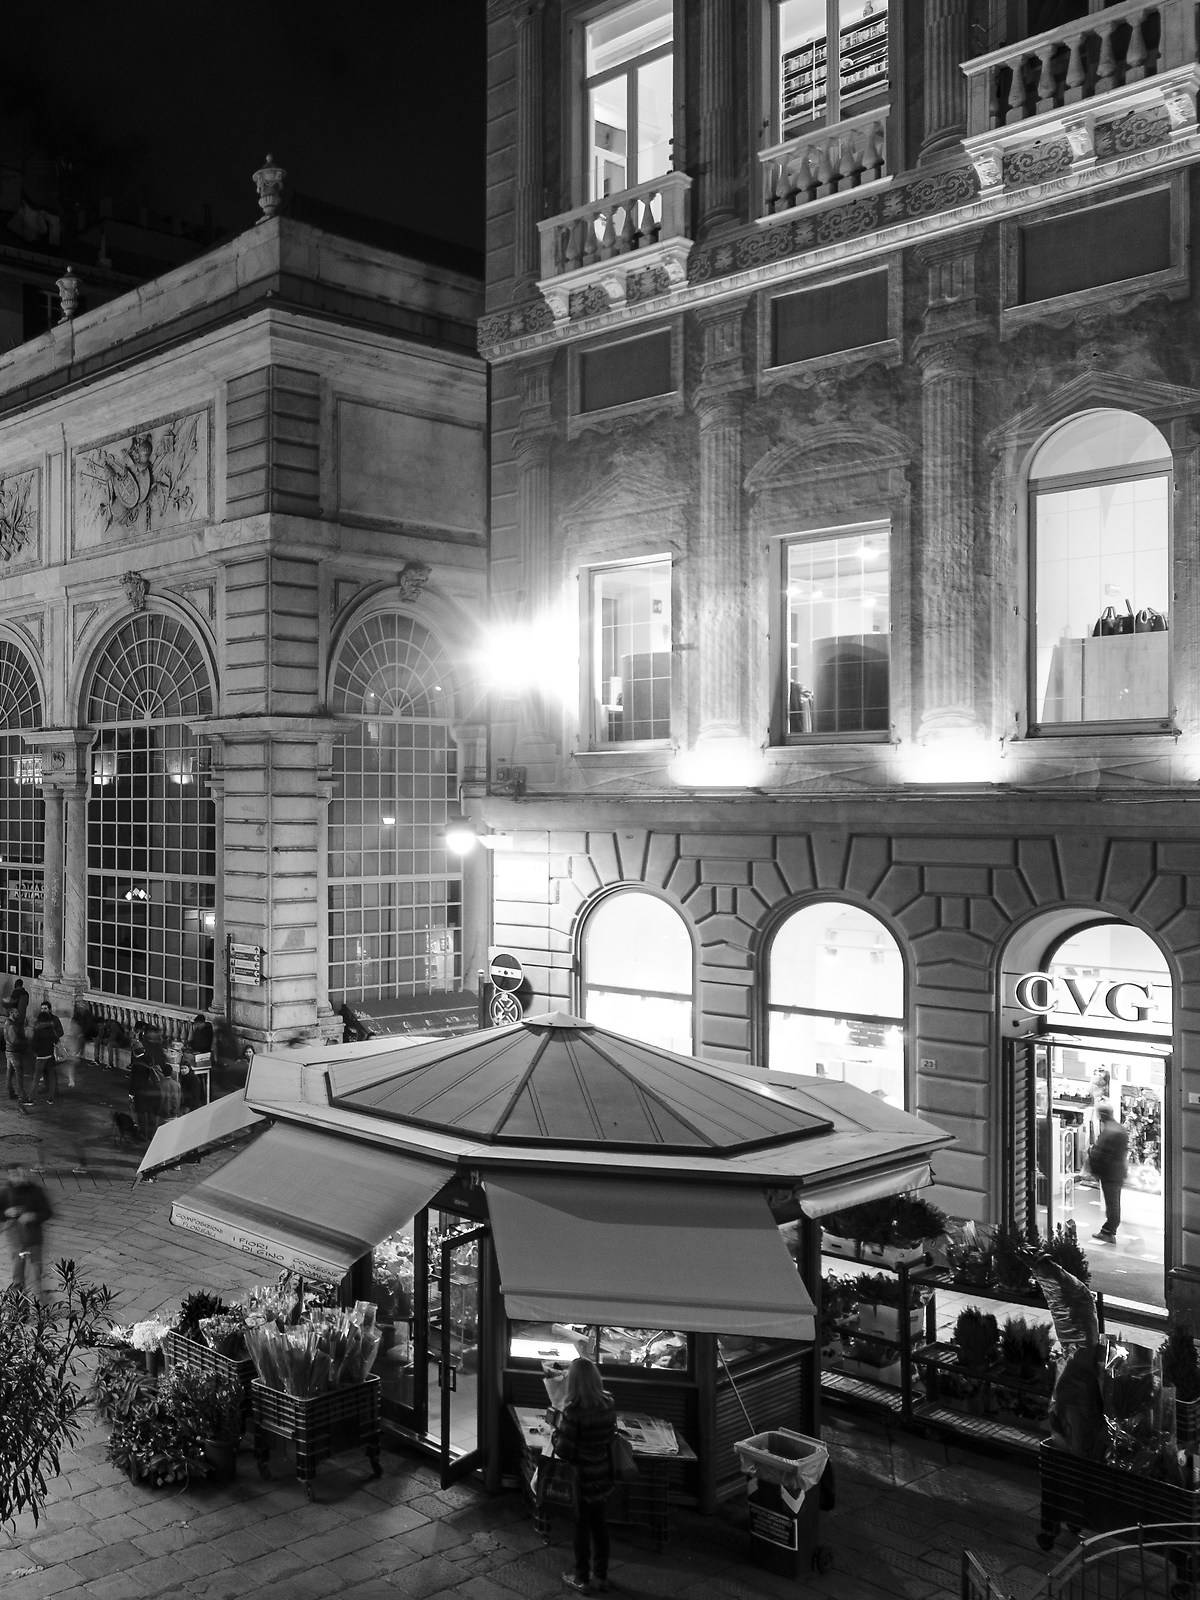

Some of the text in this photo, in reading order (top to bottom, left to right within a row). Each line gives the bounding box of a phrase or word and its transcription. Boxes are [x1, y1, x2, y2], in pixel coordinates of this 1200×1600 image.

[1014, 971, 1159, 1022] CVG
[923, 1060, 934, 1068] 23
[182, 1221, 217, 1238] FLOREALI
[239, 1237, 269, 1251] FIORI
[241, 1245, 285, 1261] DI GINO
[292, 1258, 340, 1278] CONSEGNE
